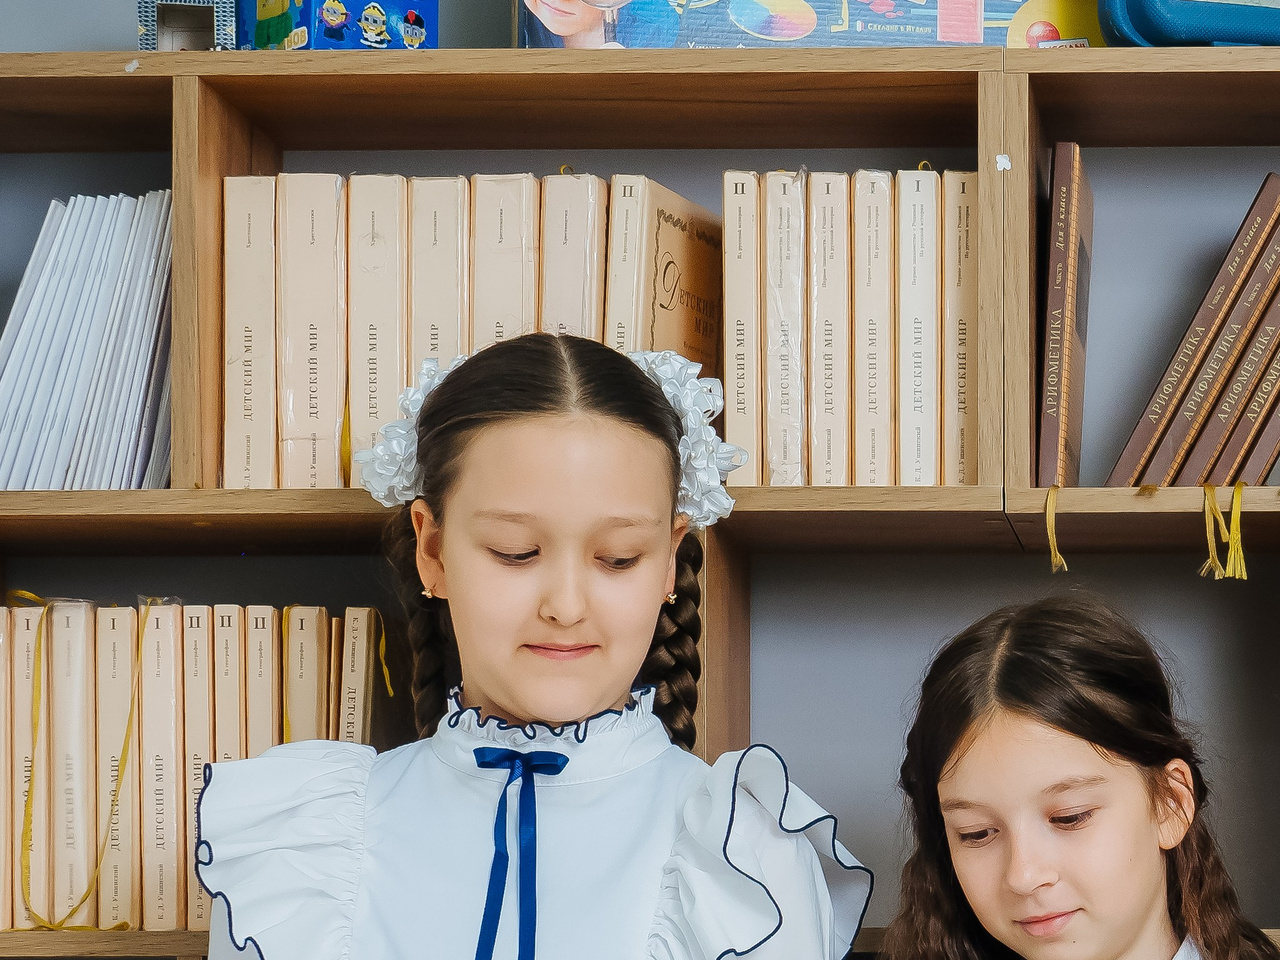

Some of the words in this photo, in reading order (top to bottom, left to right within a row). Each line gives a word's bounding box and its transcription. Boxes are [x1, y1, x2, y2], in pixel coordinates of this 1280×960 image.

[1059, 186, 1067, 219] класса
[1055, 230, 1065, 251] Для
[1055, 262, 1063, 285] часть
[737, 319, 745, 348] МИР
[825, 319, 833, 348] МИР
[868, 319, 877, 347] МИР
[914, 317, 922, 346] МИР
[958, 319, 967, 347] МИР
[1148, 325, 1206, 424] АРИФМЕТИКА
[1211, 283, 1226, 304] часть
[1226, 255, 1240, 276] Для
[1237, 248, 1244, 256] 5
[1242, 215, 1262, 248] класса
[1182, 322, 1242, 422] АРИФМЕТИКА
[1262, 252, 1277, 274] Для
[1274, 244, 1280, 252] 5
[244, 326, 253, 353] МИР
[309, 323, 318, 352] МИР
[430, 324, 439, 352] МИР
[616, 322, 626, 352] МИР
[1046, 308, 1063, 417] АРИФМЕТИКА
[1217, 324, 1276, 423] АРИФМЕТИКА
[243, 359, 254, 421] ДЕТСКИЙ
[308, 358, 319, 419] ДЕТСКИЙ
[736, 353, 747, 415] ДЕТСКИЙ
[823, 354, 835, 415] ДЕТСКИЙ
[868, 353, 878, 415] ДЕТСКИЙ
[913, 352, 924, 413] ДЕТСКИЙ
[957, 353, 968, 415] ДЕТСКИЙ
[346, 686, 357, 743] ДЕТСКИ
[156, 754, 164, 782] МИР
[193, 754, 202, 782] МИР
[155, 787, 166, 850] ДЕТСКИЙ
